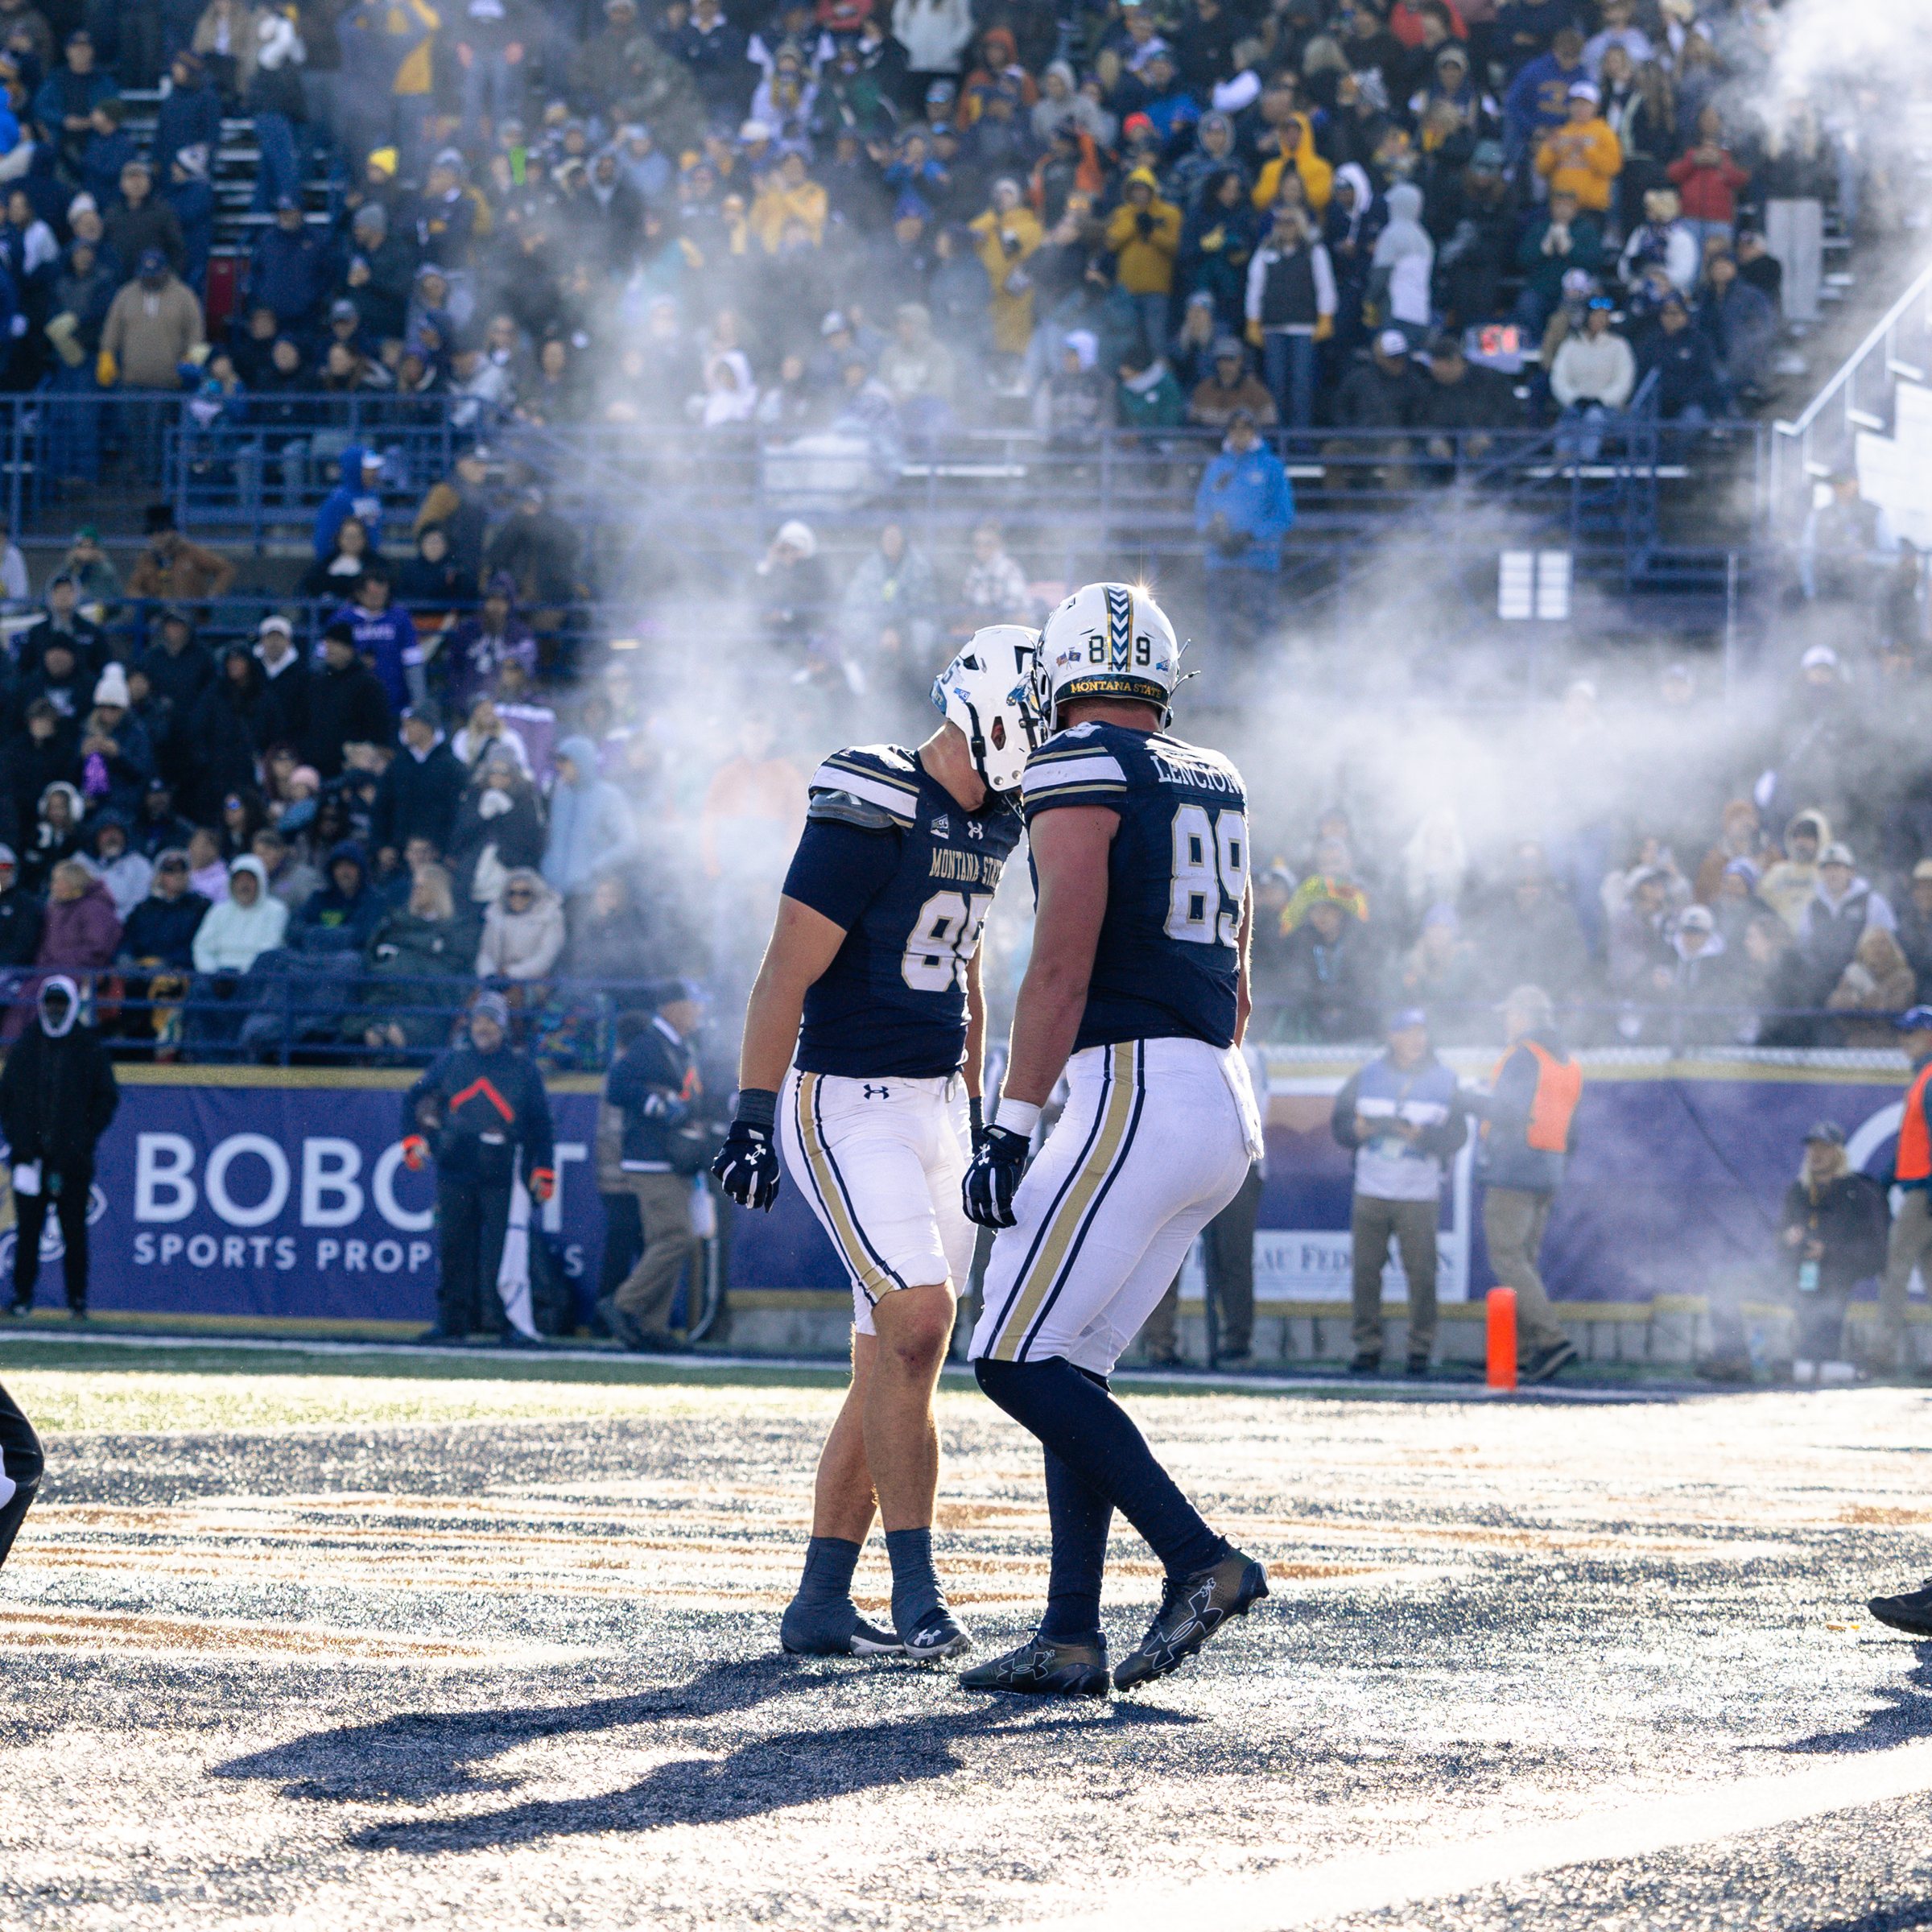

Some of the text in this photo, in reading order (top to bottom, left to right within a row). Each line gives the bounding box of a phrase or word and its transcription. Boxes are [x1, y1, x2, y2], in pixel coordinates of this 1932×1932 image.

[1088, 634, 1151, 667] 8 9
[1070, 680, 1163, 699] MONTANA STATE
[928, 847, 1003, 890] MONTANA STAT
[1162, 803, 1249, 949] 89
[134, 1131, 588, 1233] BOBCT
[134, 1232, 297, 1270] SPORTS
